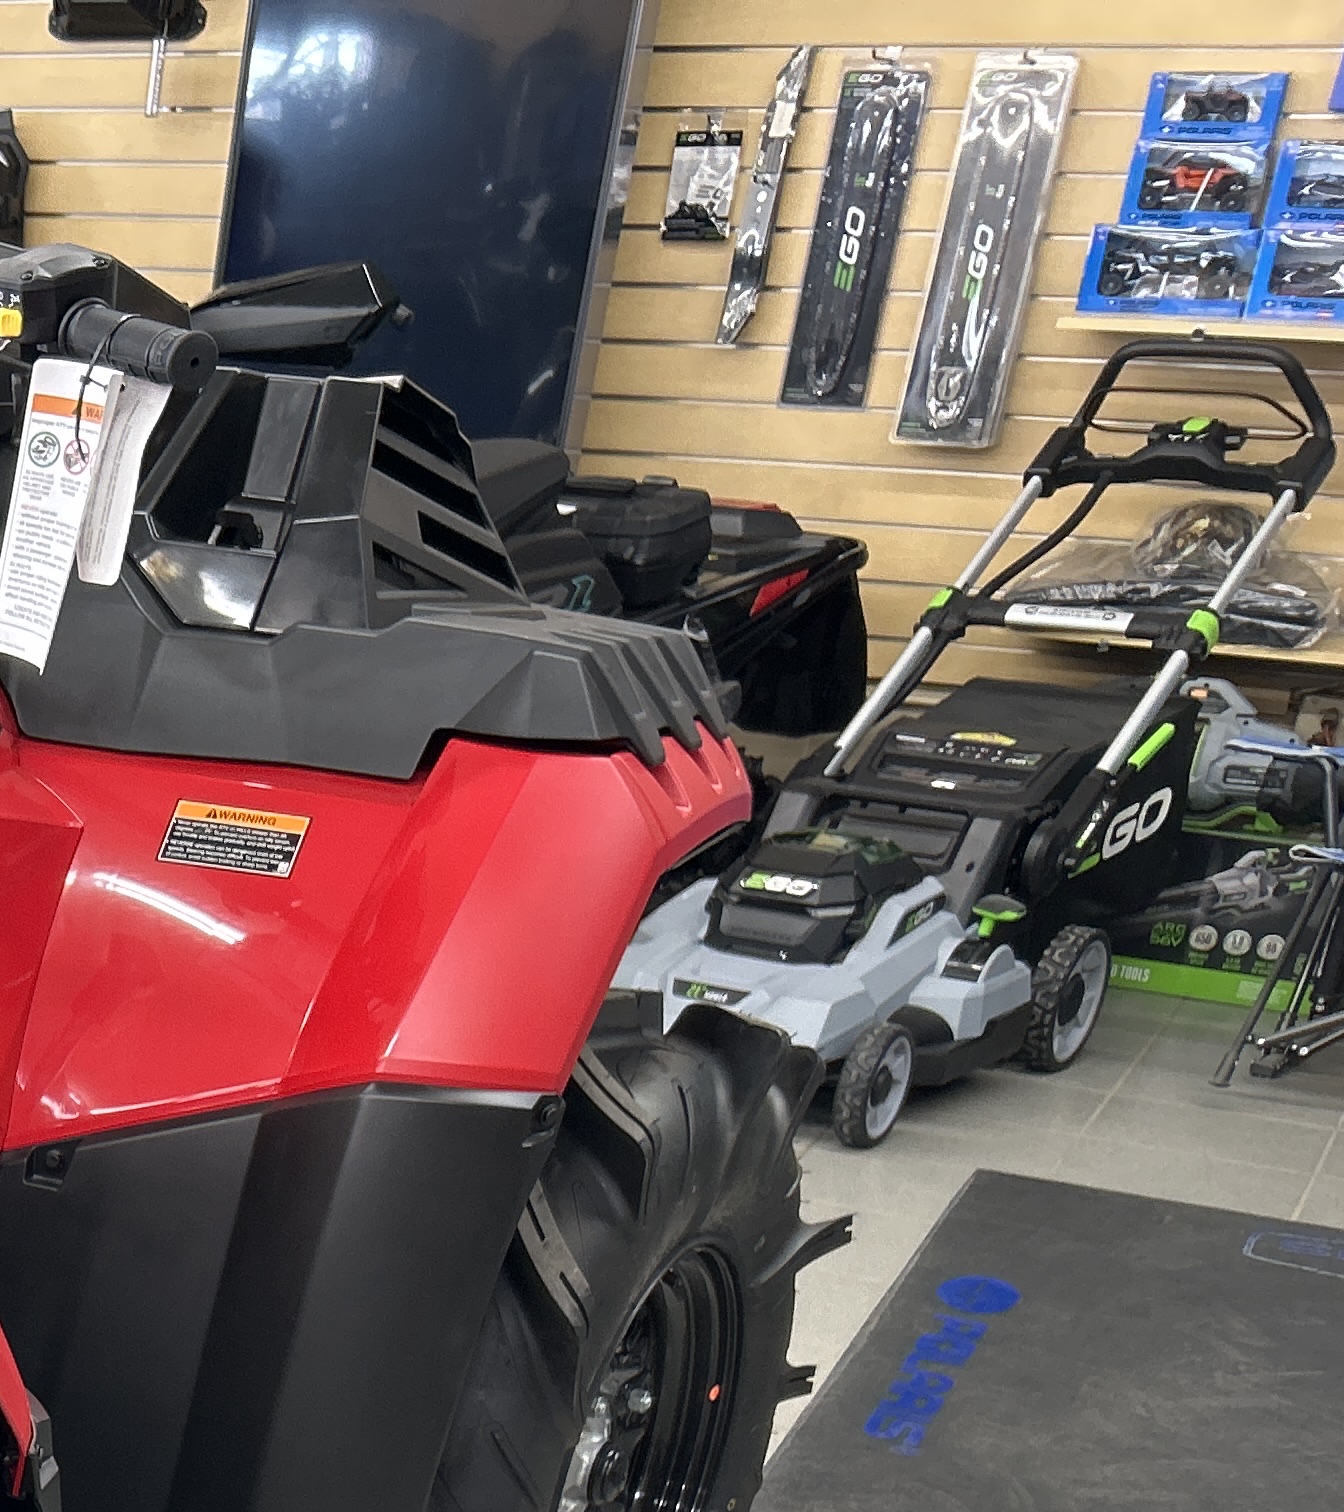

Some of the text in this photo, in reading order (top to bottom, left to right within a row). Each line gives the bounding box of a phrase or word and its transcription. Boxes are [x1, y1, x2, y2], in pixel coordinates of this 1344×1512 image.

[834, 206, 866, 292] EGO
[963, 223, 994, 301] EGO
[218, 809, 277, 827] WARNING
[1100, 787, 1173, 861] GO
[1120, 966, 1151, 983] TOOLS
[864, 1312, 989, 1457] POLARIS
